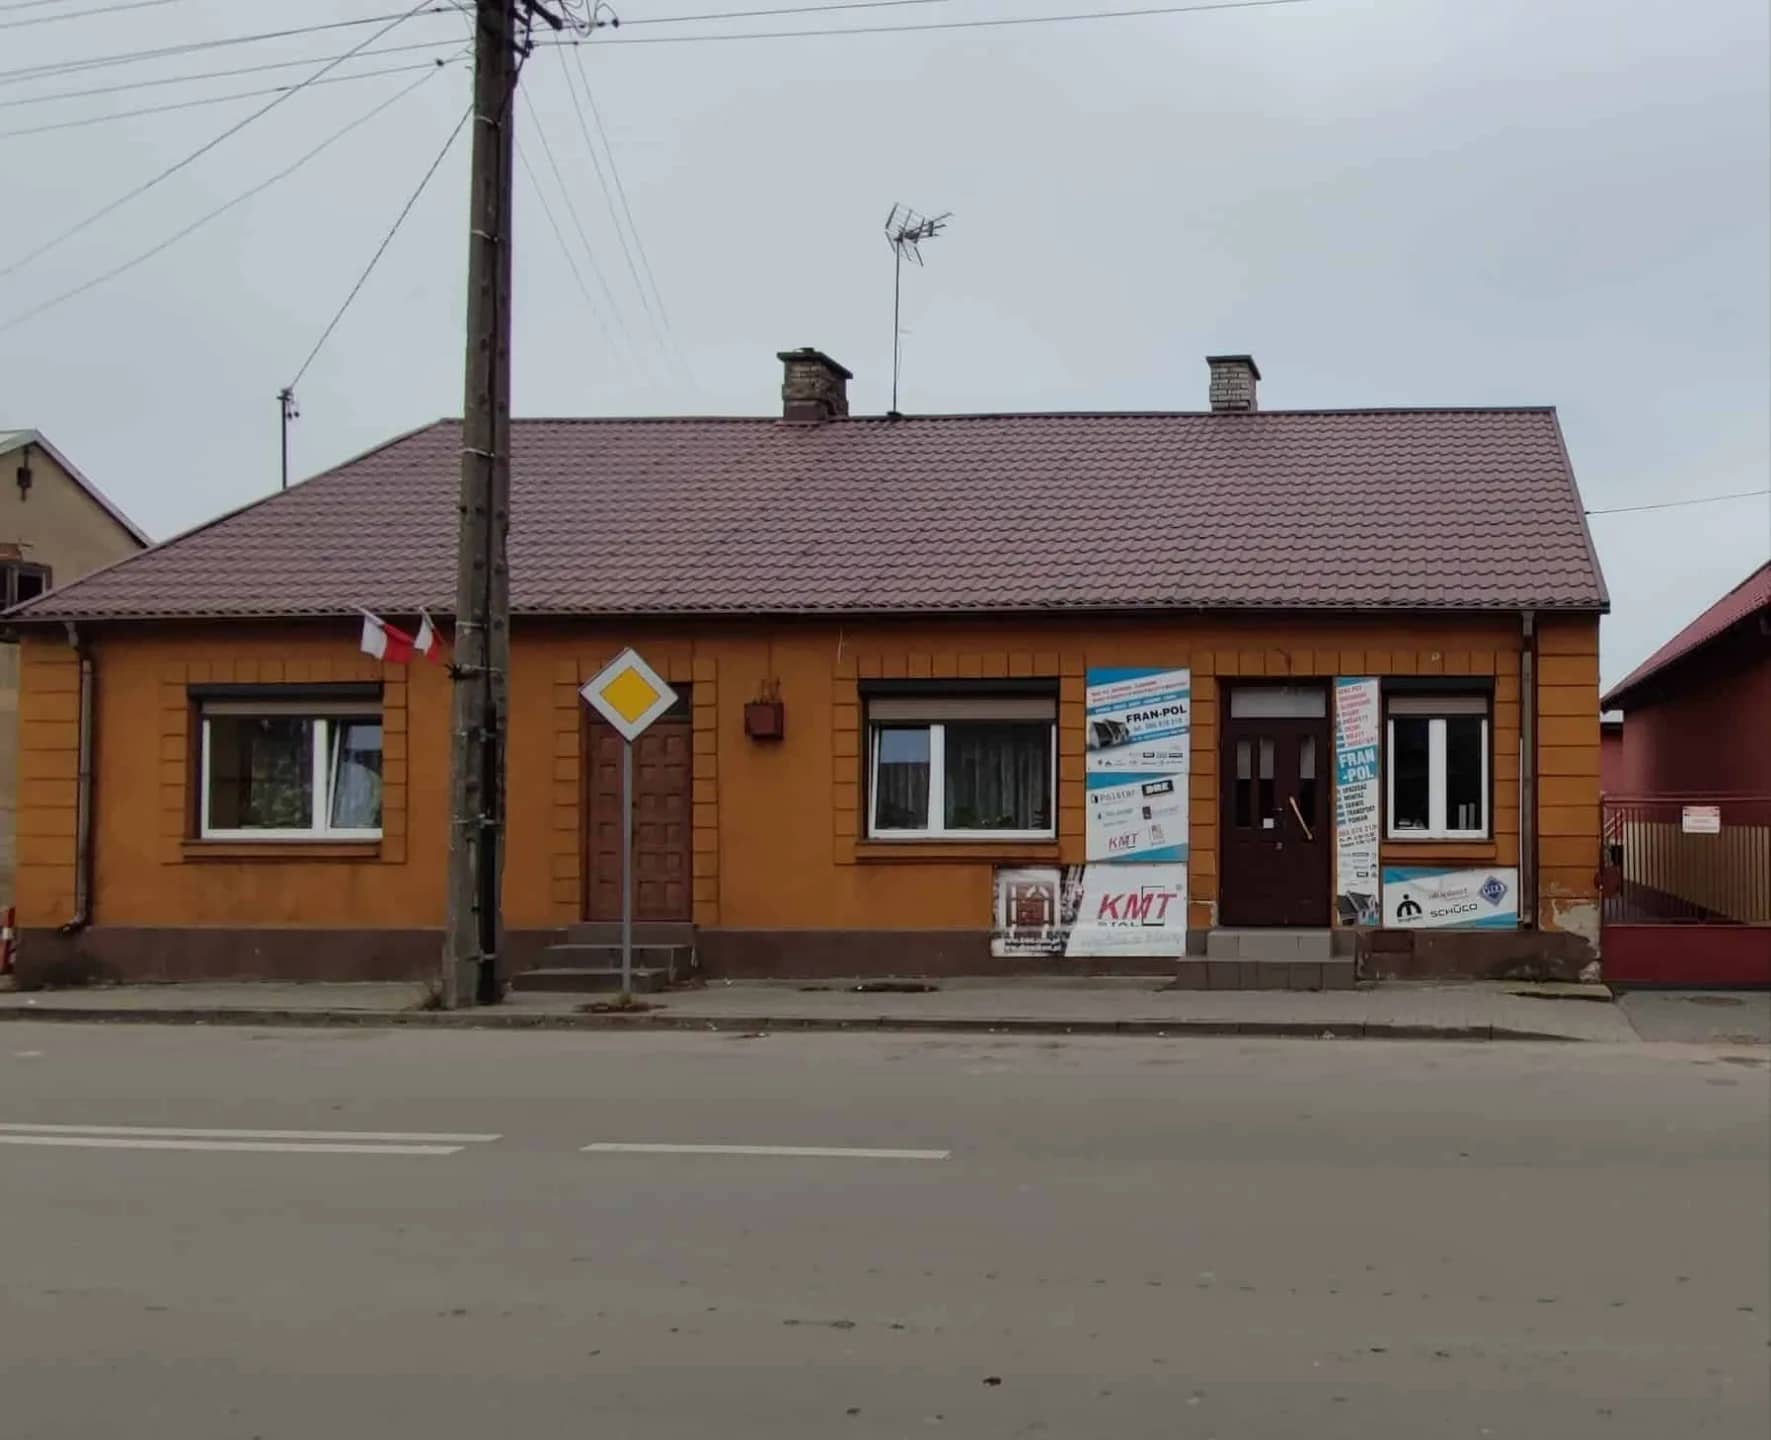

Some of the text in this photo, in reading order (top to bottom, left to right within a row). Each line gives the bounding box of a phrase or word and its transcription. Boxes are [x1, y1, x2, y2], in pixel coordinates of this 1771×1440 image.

[1126, 704, 1187, 723] FRAN-POL
[1339, 748, 1375, 769] FRAN
[1342, 765, 1375, 783] -POL
[1108, 833, 1139, 849] KMT
[1097, 893, 1177, 920] KMT
